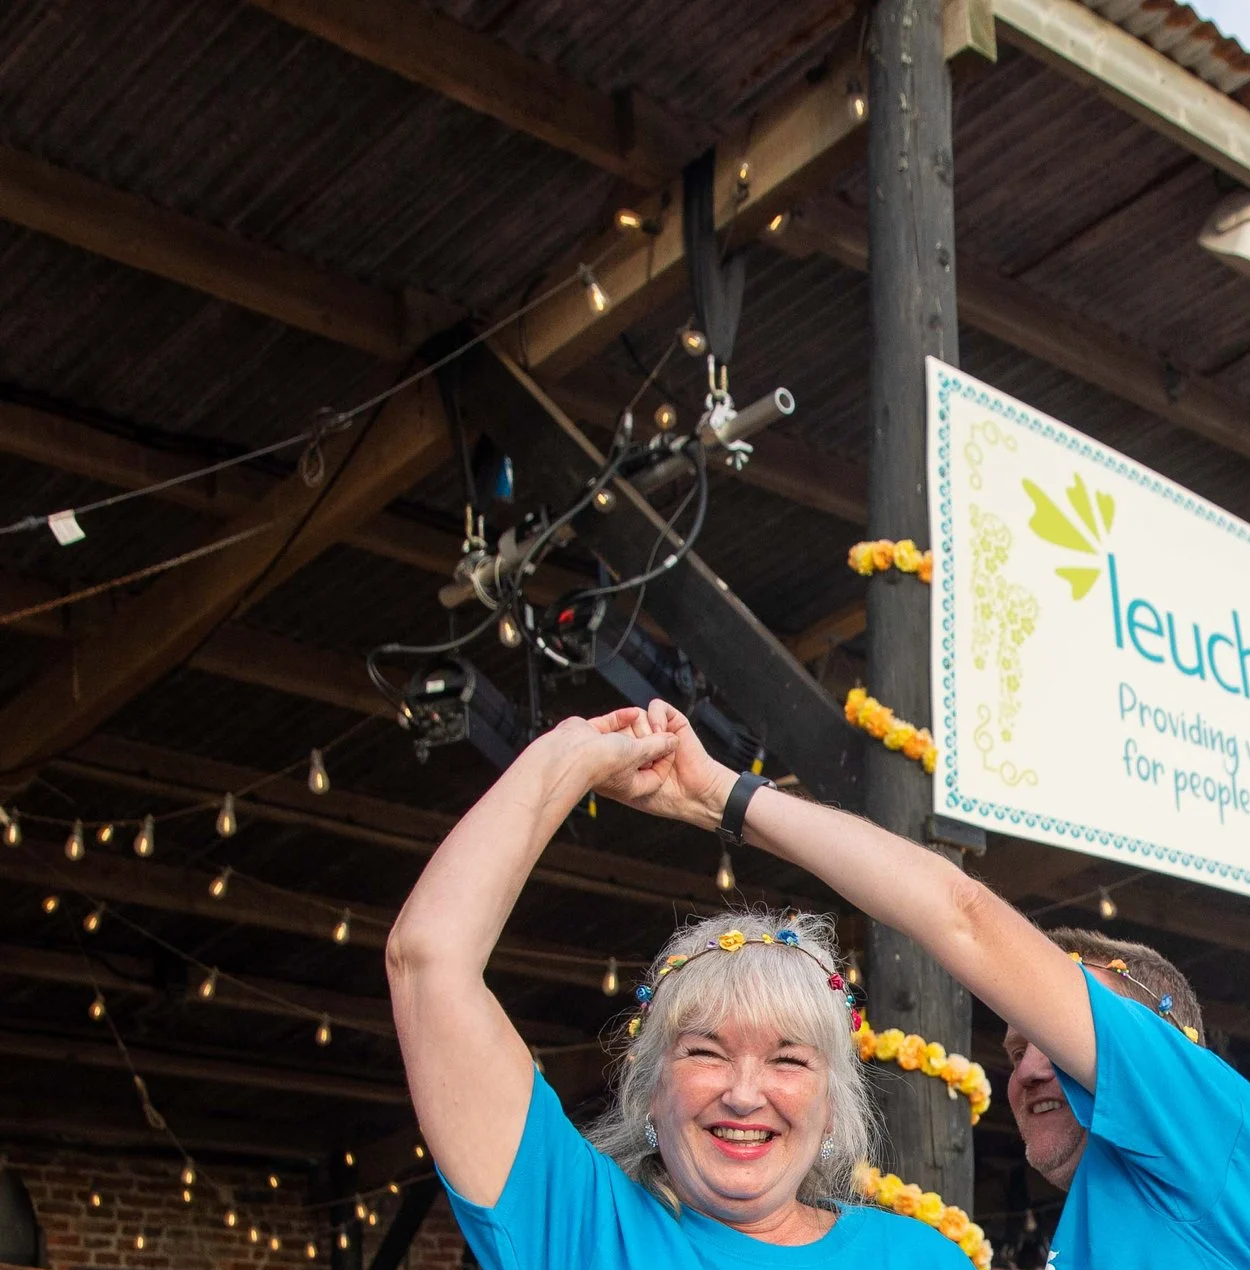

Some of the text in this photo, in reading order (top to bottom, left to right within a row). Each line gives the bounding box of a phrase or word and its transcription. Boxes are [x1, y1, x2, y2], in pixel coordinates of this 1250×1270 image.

[1119, 682, 1239, 776] Providing
[1123, 737, 1165, 785] for
[1174, 767, 1250, 825] people
